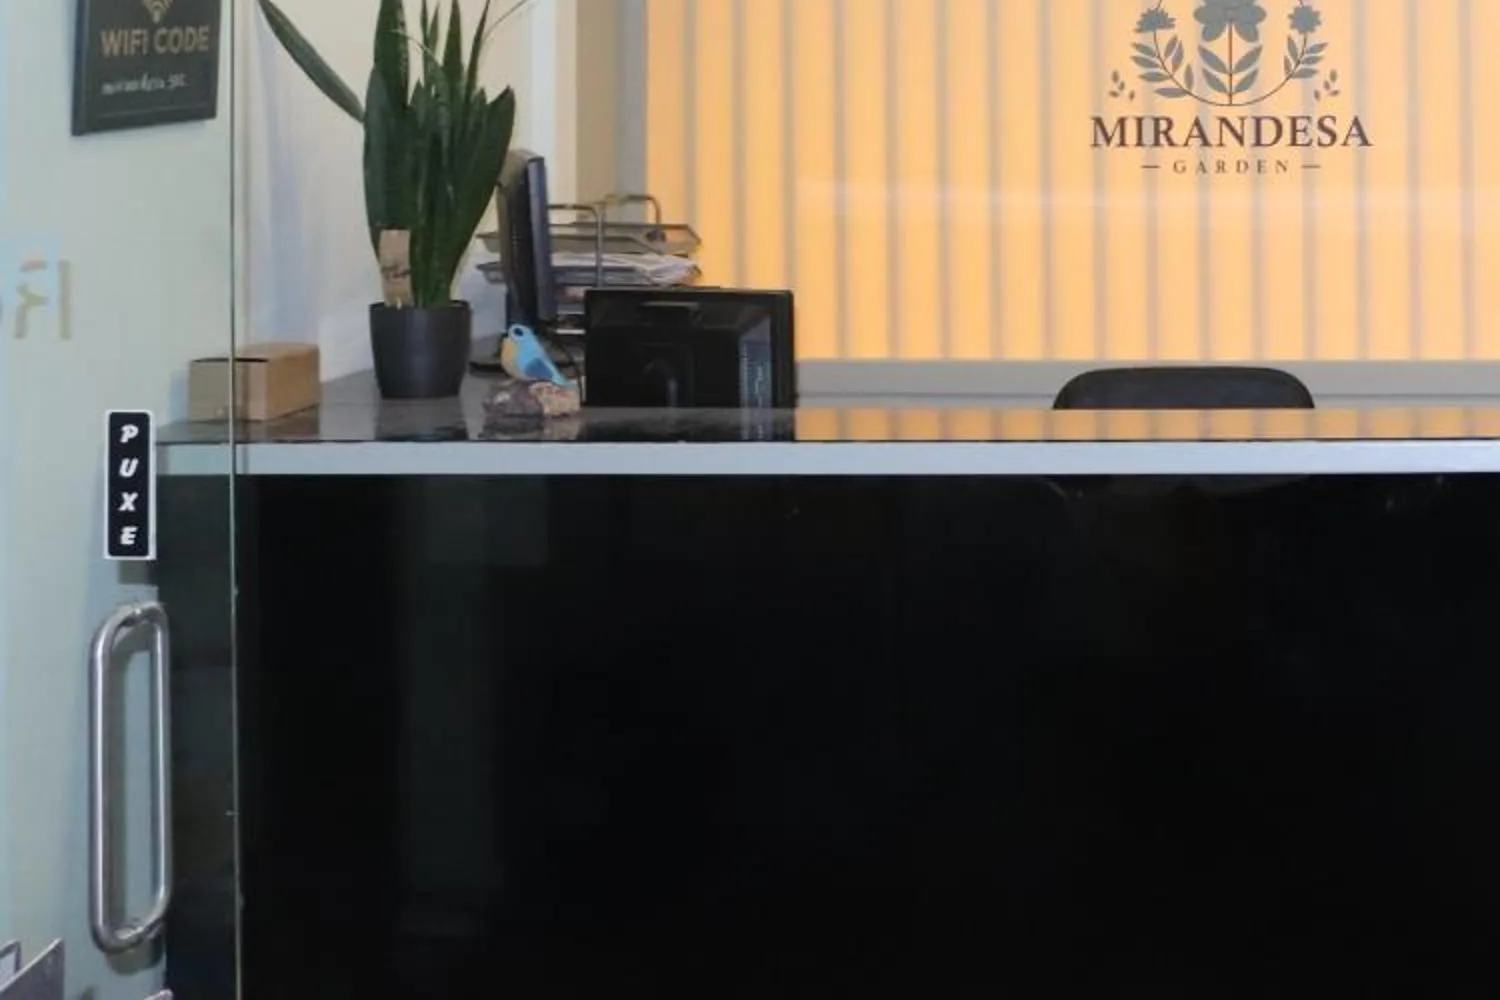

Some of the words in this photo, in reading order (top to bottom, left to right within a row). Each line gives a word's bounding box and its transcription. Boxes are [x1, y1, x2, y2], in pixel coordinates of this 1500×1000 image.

[101, 28, 148, 57] WIFI
[153, 25, 209, 54] CODE
[1090, 115, 1372, 148] MIRANDESA
[1173, 159, 1290, 174] GARDEN
[118, 425, 139, 546] PUXE
